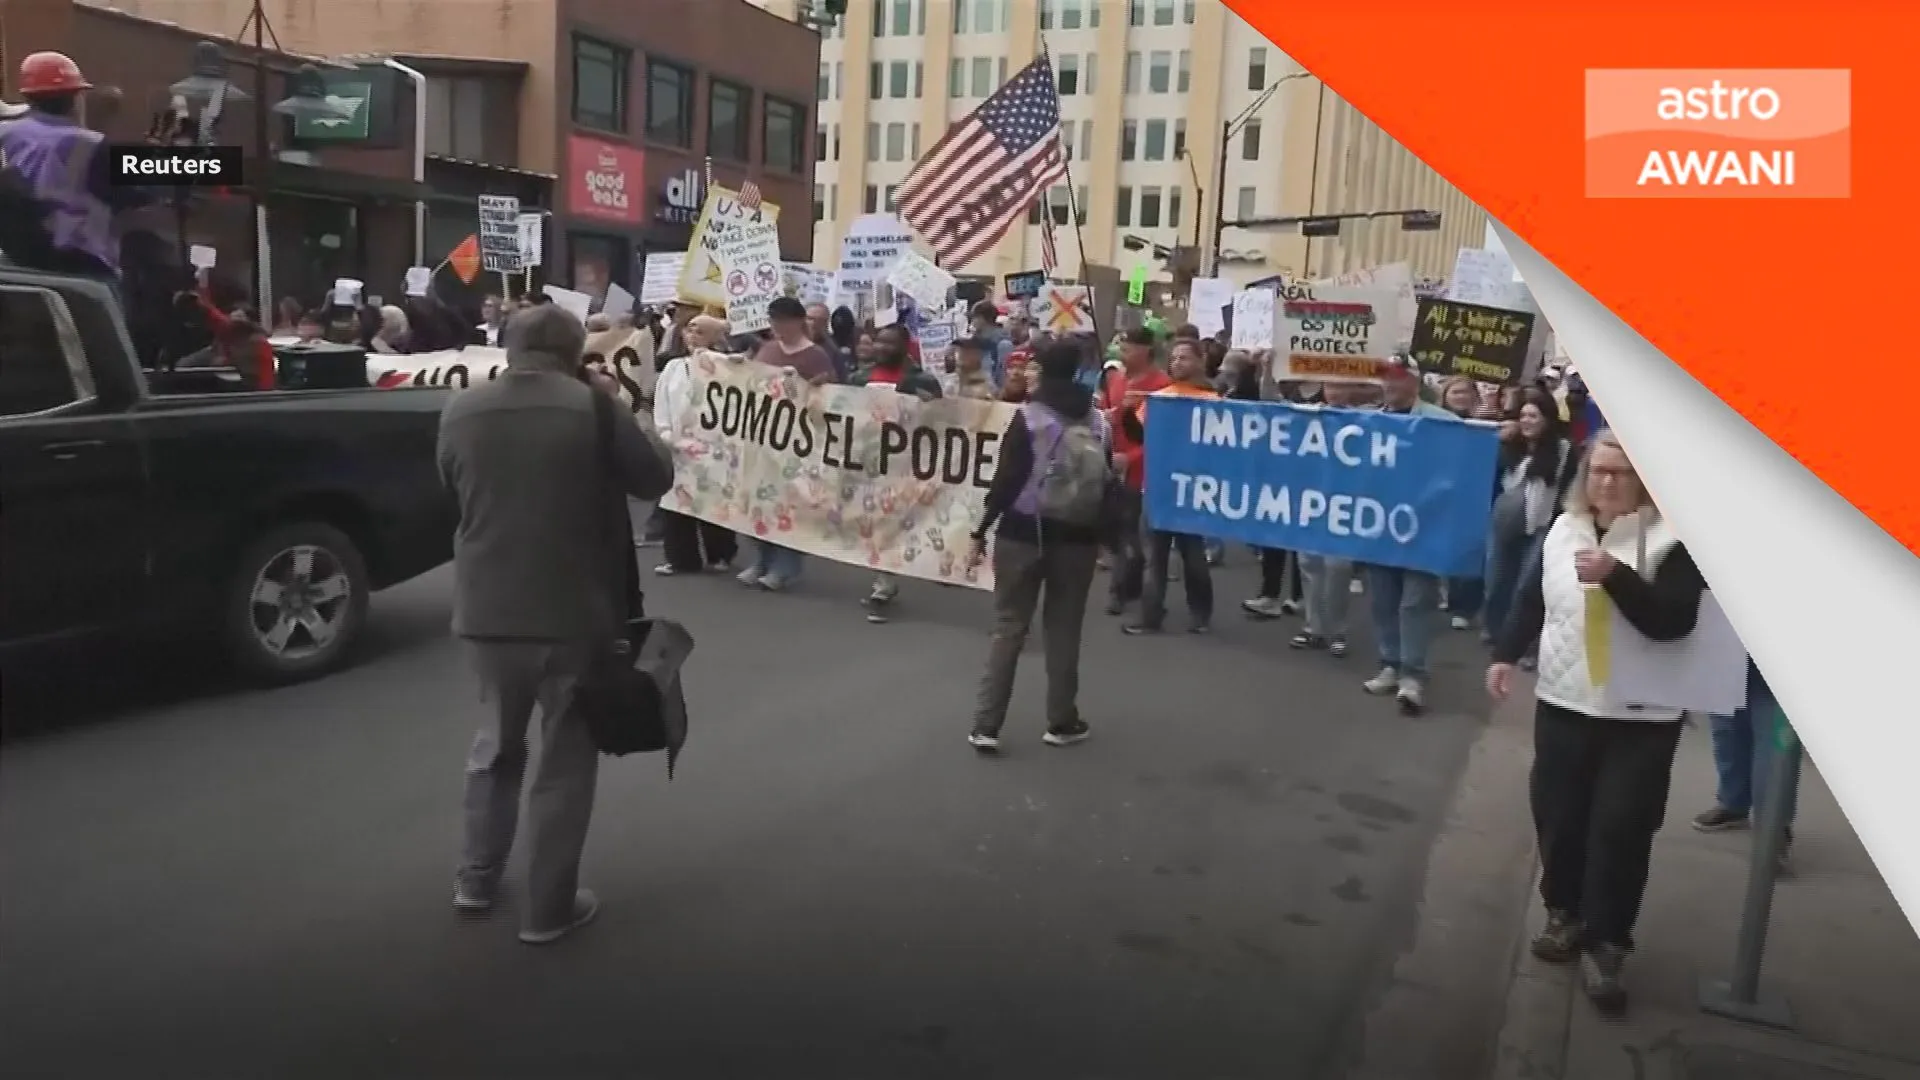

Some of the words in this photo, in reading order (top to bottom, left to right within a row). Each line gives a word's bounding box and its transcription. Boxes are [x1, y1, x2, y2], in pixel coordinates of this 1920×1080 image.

[586, 170, 624, 192] good
[593, 189, 628, 208] eats
[665, 206, 698, 224] KITC
[1276, 285, 1317, 302] REAL
[1302, 318, 1325, 332] DO
[1332, 320, 1370, 339] NOT
[1290, 335, 1369, 354] PROTECT
[701, 380, 814, 459] SOMOS
[823, 412, 864, 472] EL
[879, 421, 999, 489] PODE
[1190, 406, 1397, 467] IMPEACH
[1170, 472, 1419, 544] TRUMPEDO
